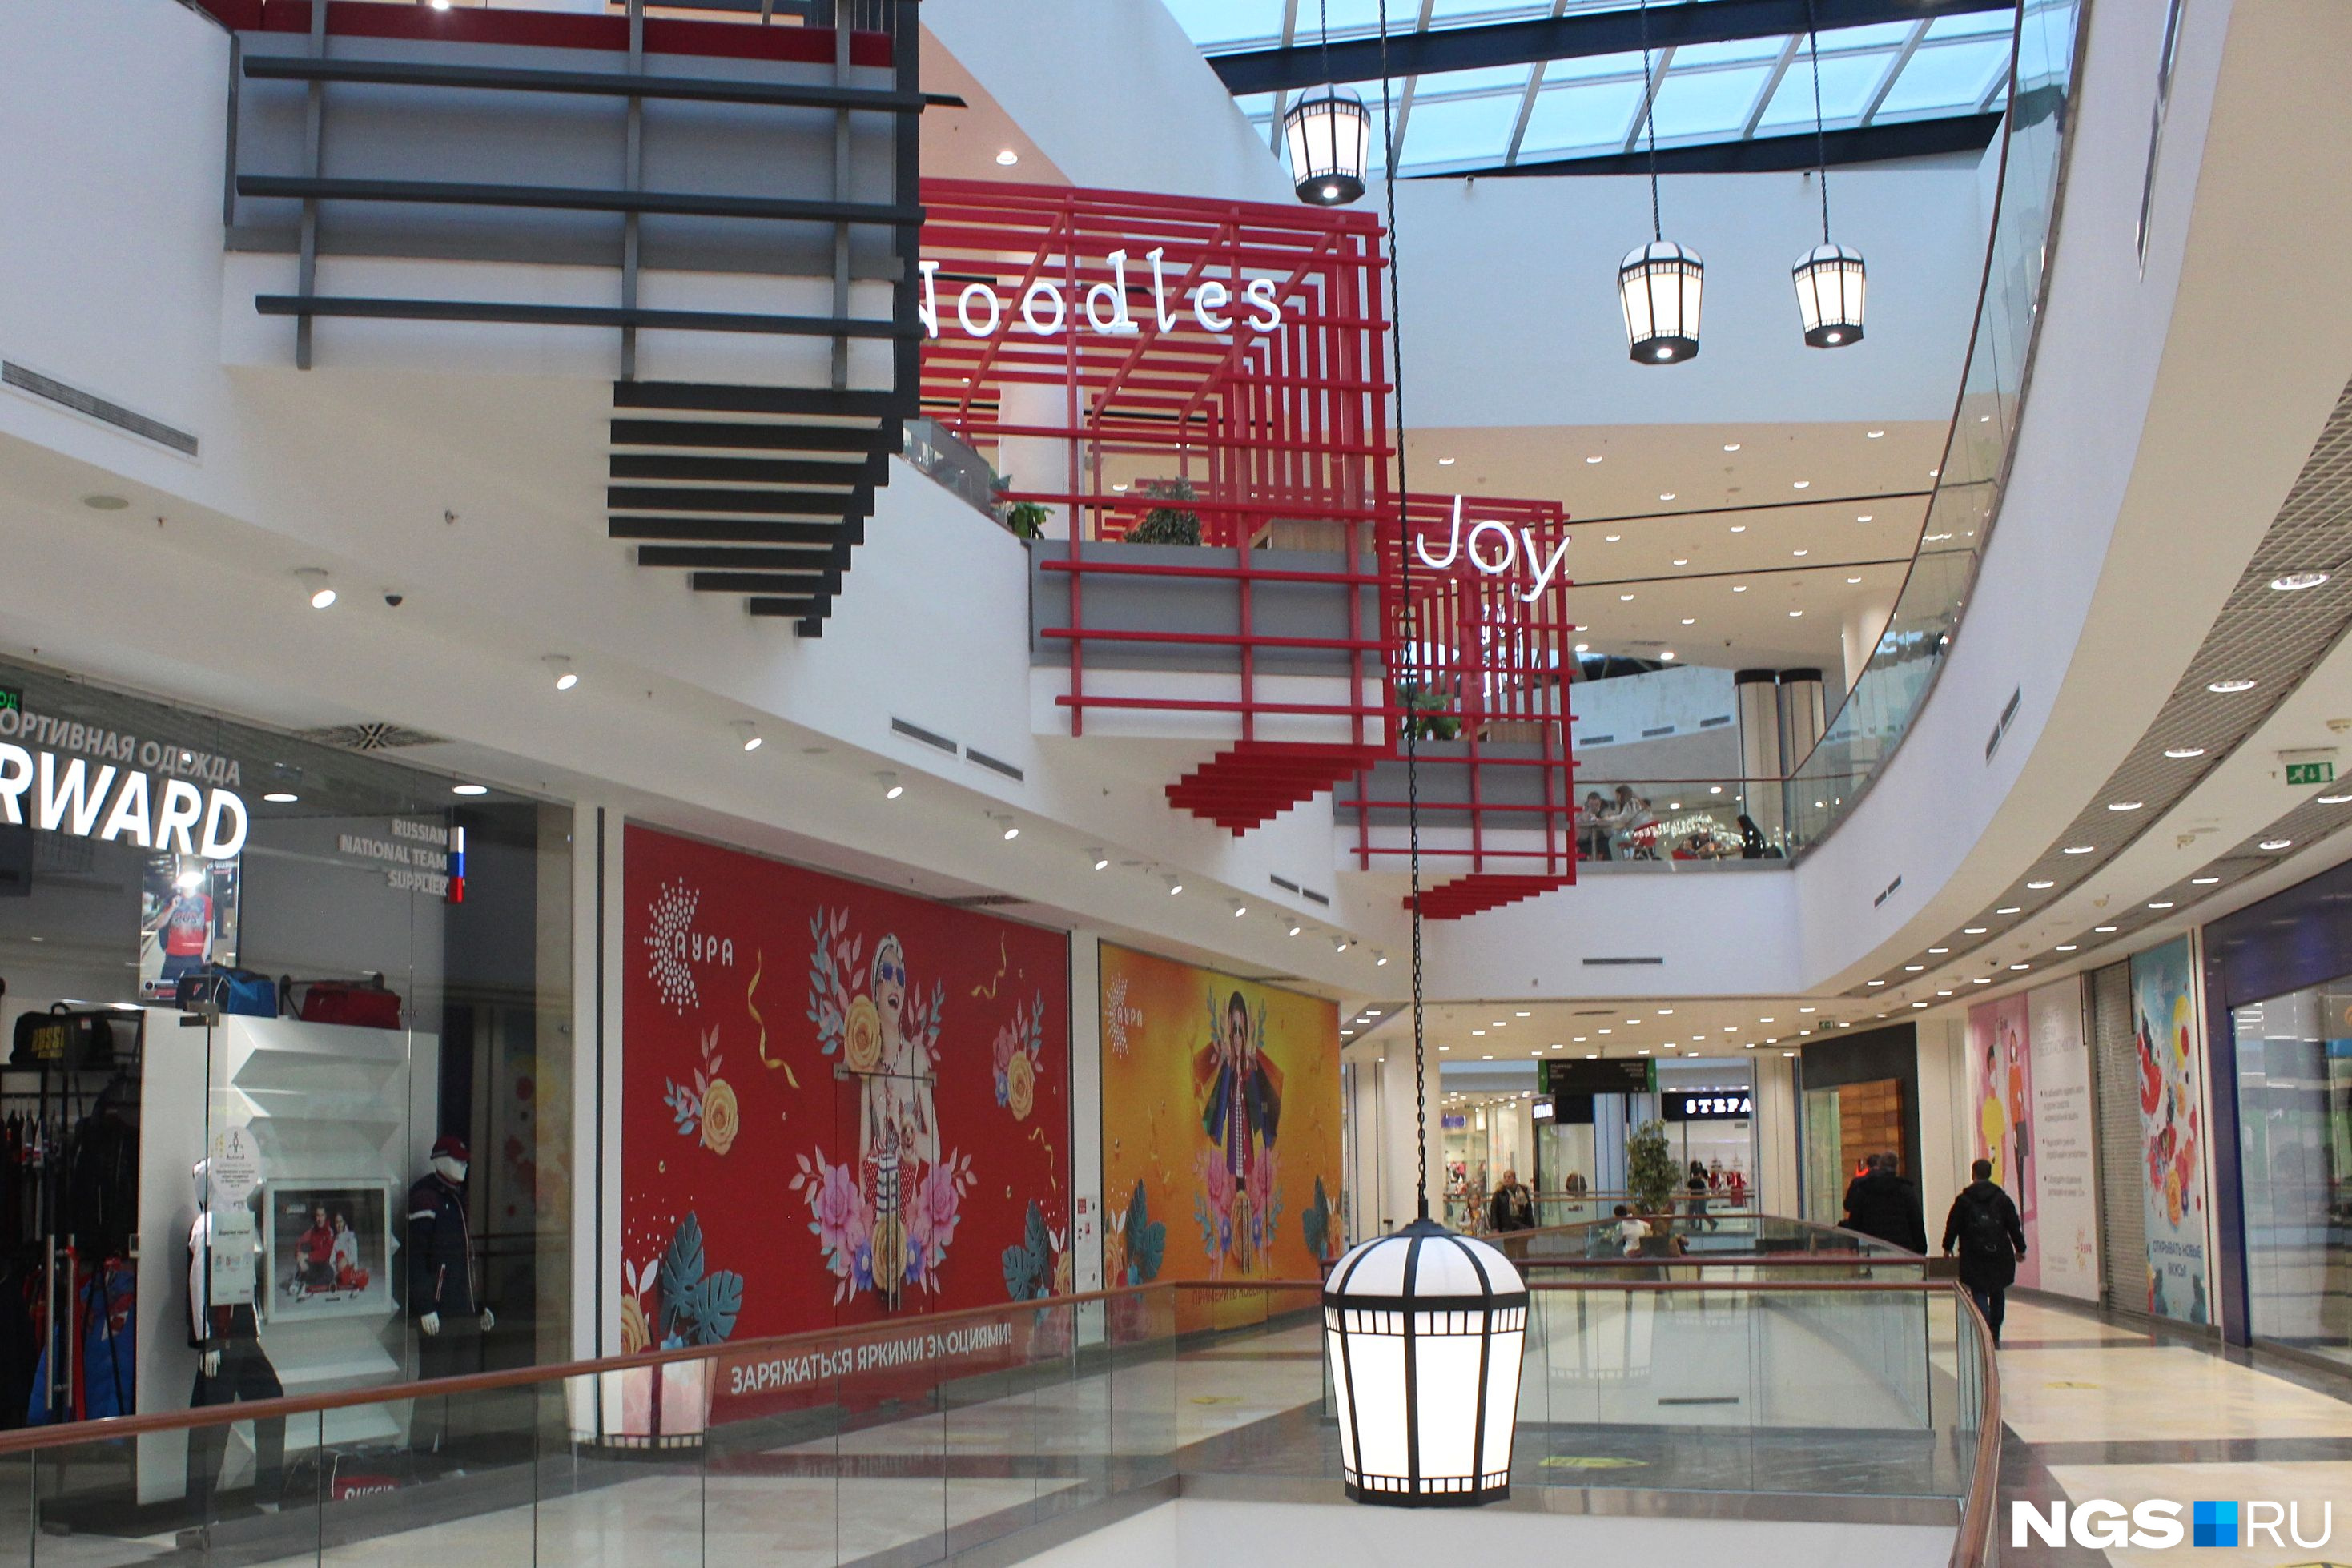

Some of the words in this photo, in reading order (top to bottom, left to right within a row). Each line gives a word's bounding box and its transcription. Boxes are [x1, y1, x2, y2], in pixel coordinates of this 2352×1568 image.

[1417, 493, 1570, 602] Joy
[139, 741, 240, 786] ОДЕЖДА
[392, 818, 448, 845] RUSSIAN
[337, 834, 411, 863] NATIONAL
[412, 847, 448, 870] TEAM
[388, 870, 449, 896] SUPPLIER
[675, 931, 733, 966] АУРА
[730, 1348, 853, 1394] ЗАРЯЖАТЬСЯ
[857, 1337, 923, 1371] ЯРКИМИ
